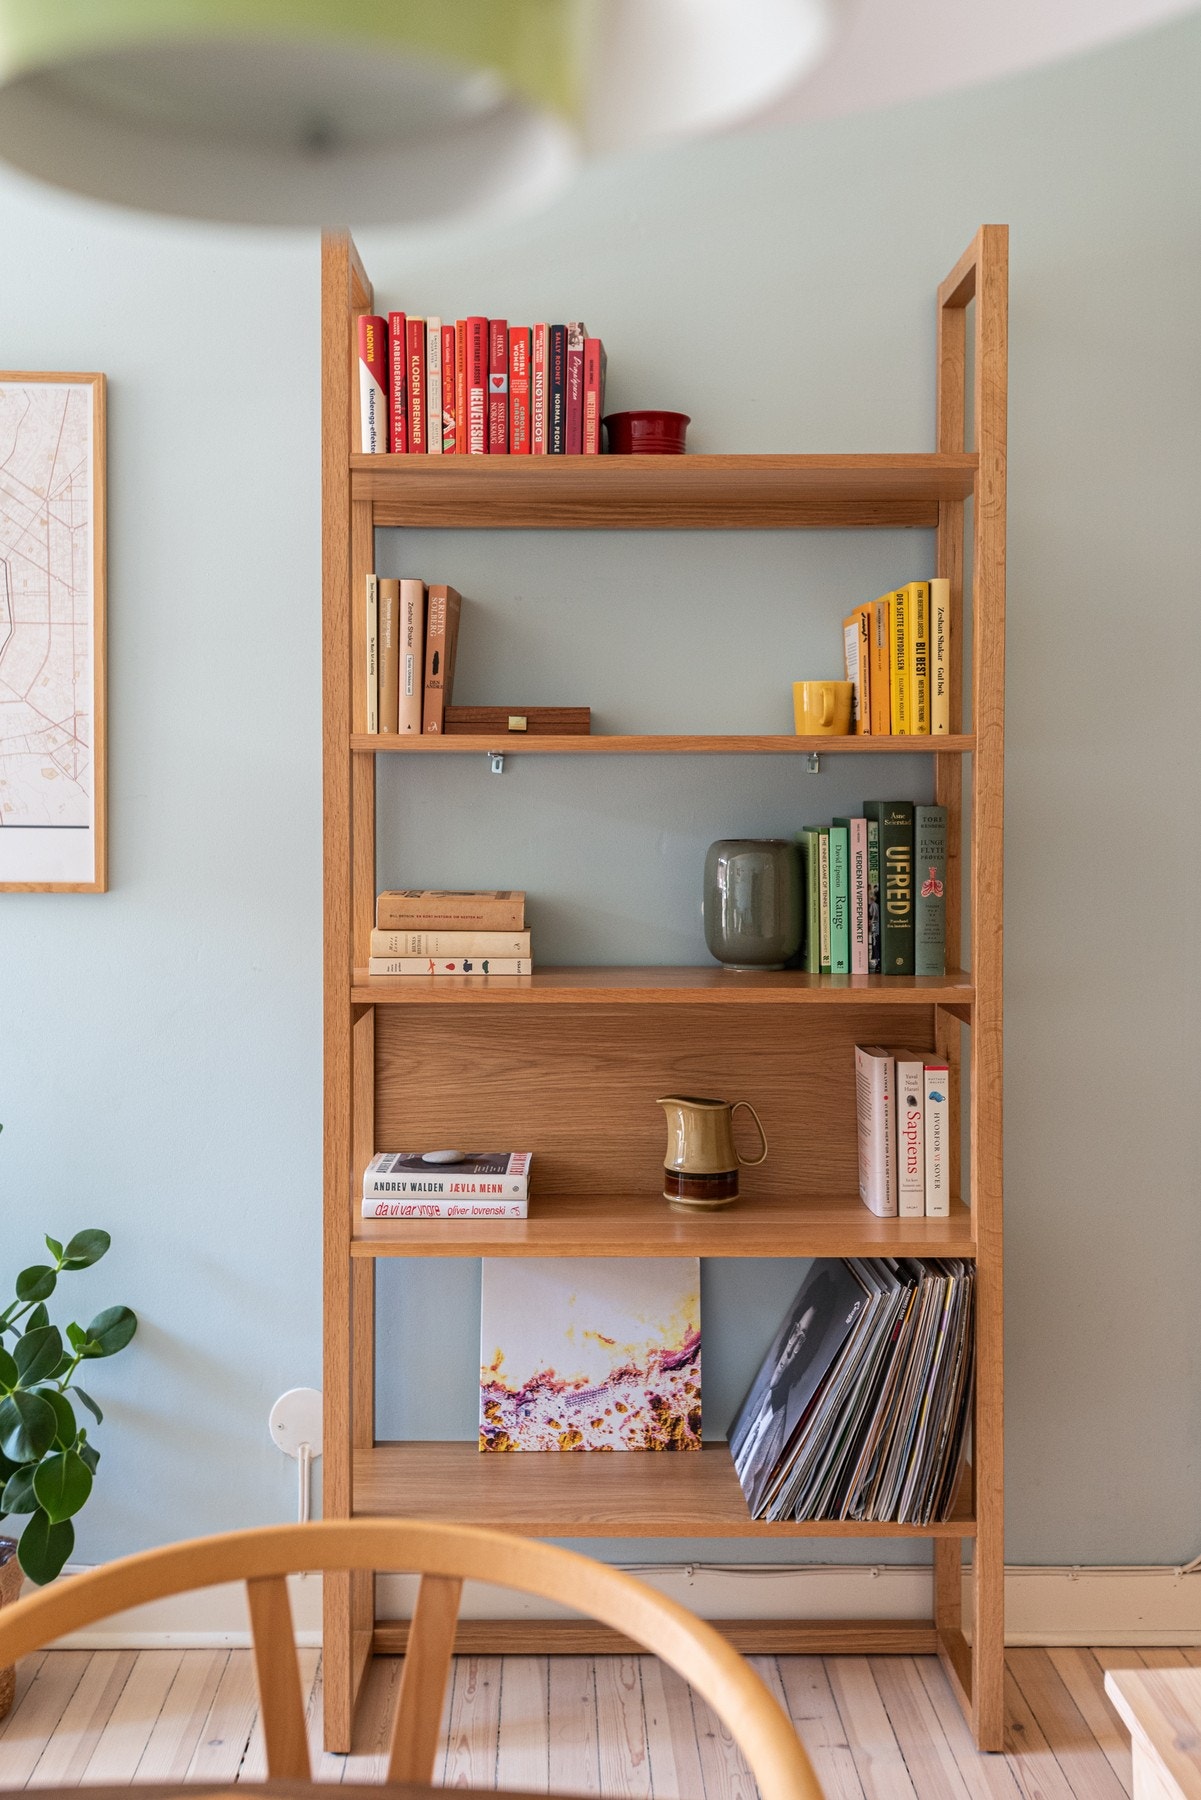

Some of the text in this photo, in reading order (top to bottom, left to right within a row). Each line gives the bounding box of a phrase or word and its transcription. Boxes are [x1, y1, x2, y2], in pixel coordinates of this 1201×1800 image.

[366, 324, 374, 362] ANONYM
[393, 340, 402, 414] ARBEIDERPARTIET
[412, 355, 421, 444] KLODEN BRENNER
[535, 372, 543, 442] BORGERLØNN
[586, 391, 596, 418] NINETEEN
[430, 596, 438, 637] SOLBERG
[438, 597, 446, 635] KRISTIN
[896, 607, 904, 628] SJETTE
[915, 642, 925, 655] BLI
[916, 657, 926, 677] BEST
[869, 840, 878, 850] DE
[869, 850, 878, 872] ANDRE
[834, 865, 842, 888] Epstein
[856, 880, 865, 890] PÅ
[886, 846, 910, 914] UFRED
[833, 895, 846, 930] Range
[902, 1111, 921, 1174] Sapiens
[934, 1153, 940, 1162] VI
[373, 1182, 503, 1193] ANDREV WALDEN JÆVLA MENN
[375, 1202, 506, 1218] da vi var yngre oliver lovrenski
